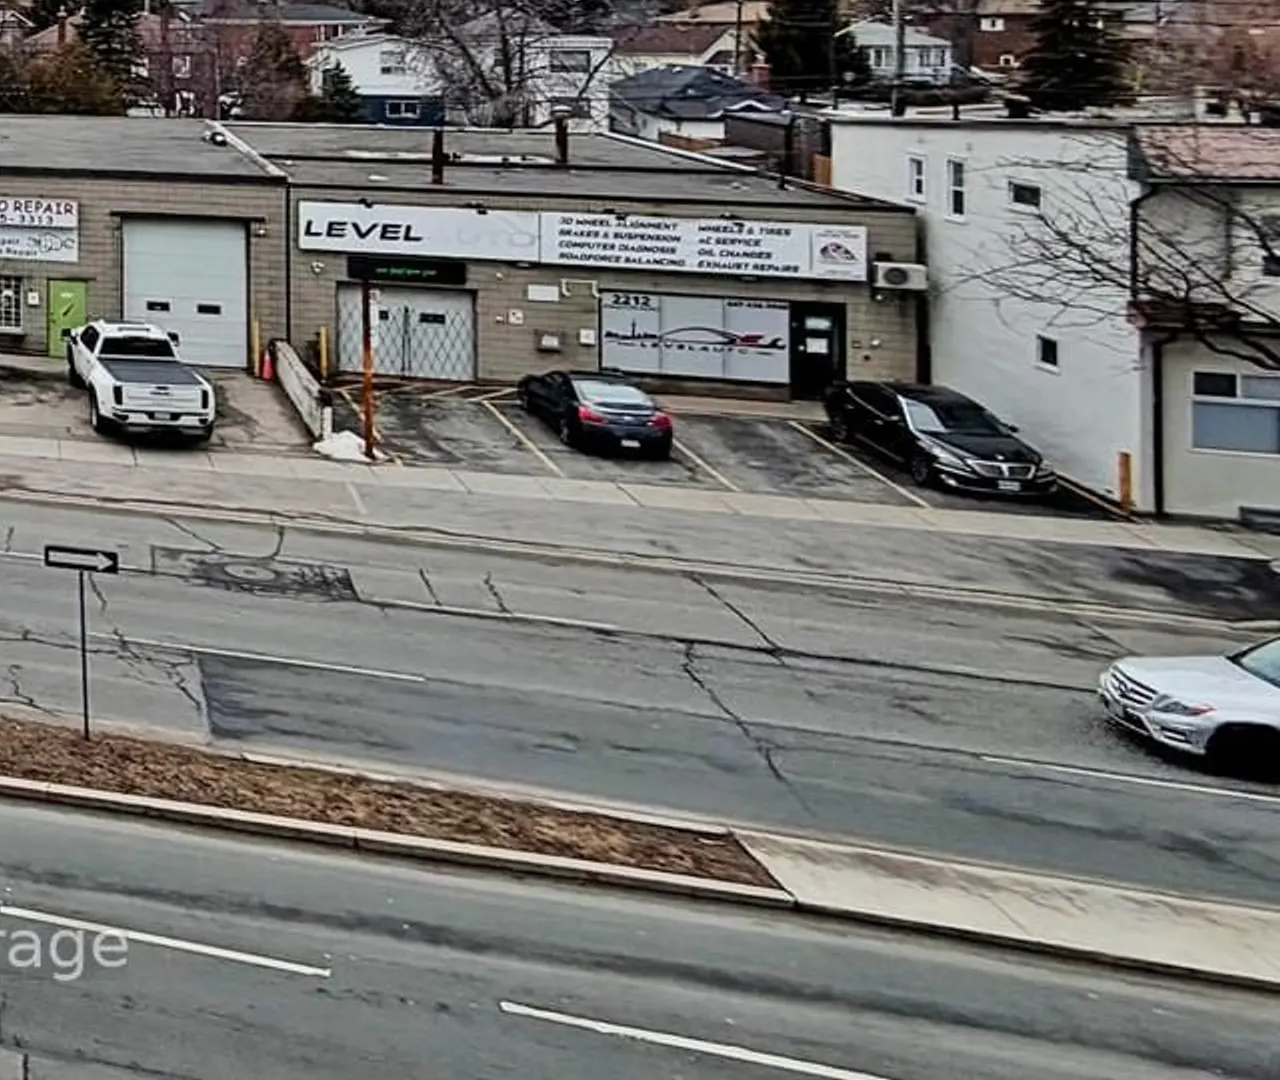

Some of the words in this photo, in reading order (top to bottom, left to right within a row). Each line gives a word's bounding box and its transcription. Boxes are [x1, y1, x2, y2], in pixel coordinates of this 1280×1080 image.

[13, 200, 74, 215] REPAIR
[304, 220, 423, 241] LEVEL
[575, 218, 611, 227] WHEEL
[616, 220, 679, 231] ALIGNMENT
[697, 224, 744, 234] WHEELS
[759, 228, 792, 236] TIRES
[558, 228, 600, 237] BRAKES
[612, 231, 682, 242] SUSPENSION
[558, 240, 616, 251] COMPUTER
[618, 243, 677, 254] DIAGNOSIS
[715, 238, 763, 247] SERVICE
[6, 247, 38, 257] Repair
[697, 248, 715, 257] OIL
[719, 249, 773, 259] CHANGES
[558, 252, 622, 263] ROADFORCE
[624, 256, 686, 267] BALANCING
[697, 260, 750, 270] EXHAUST
[752, 262, 800, 273] REPAIRS
[612, 294, 652, 307] 2212
